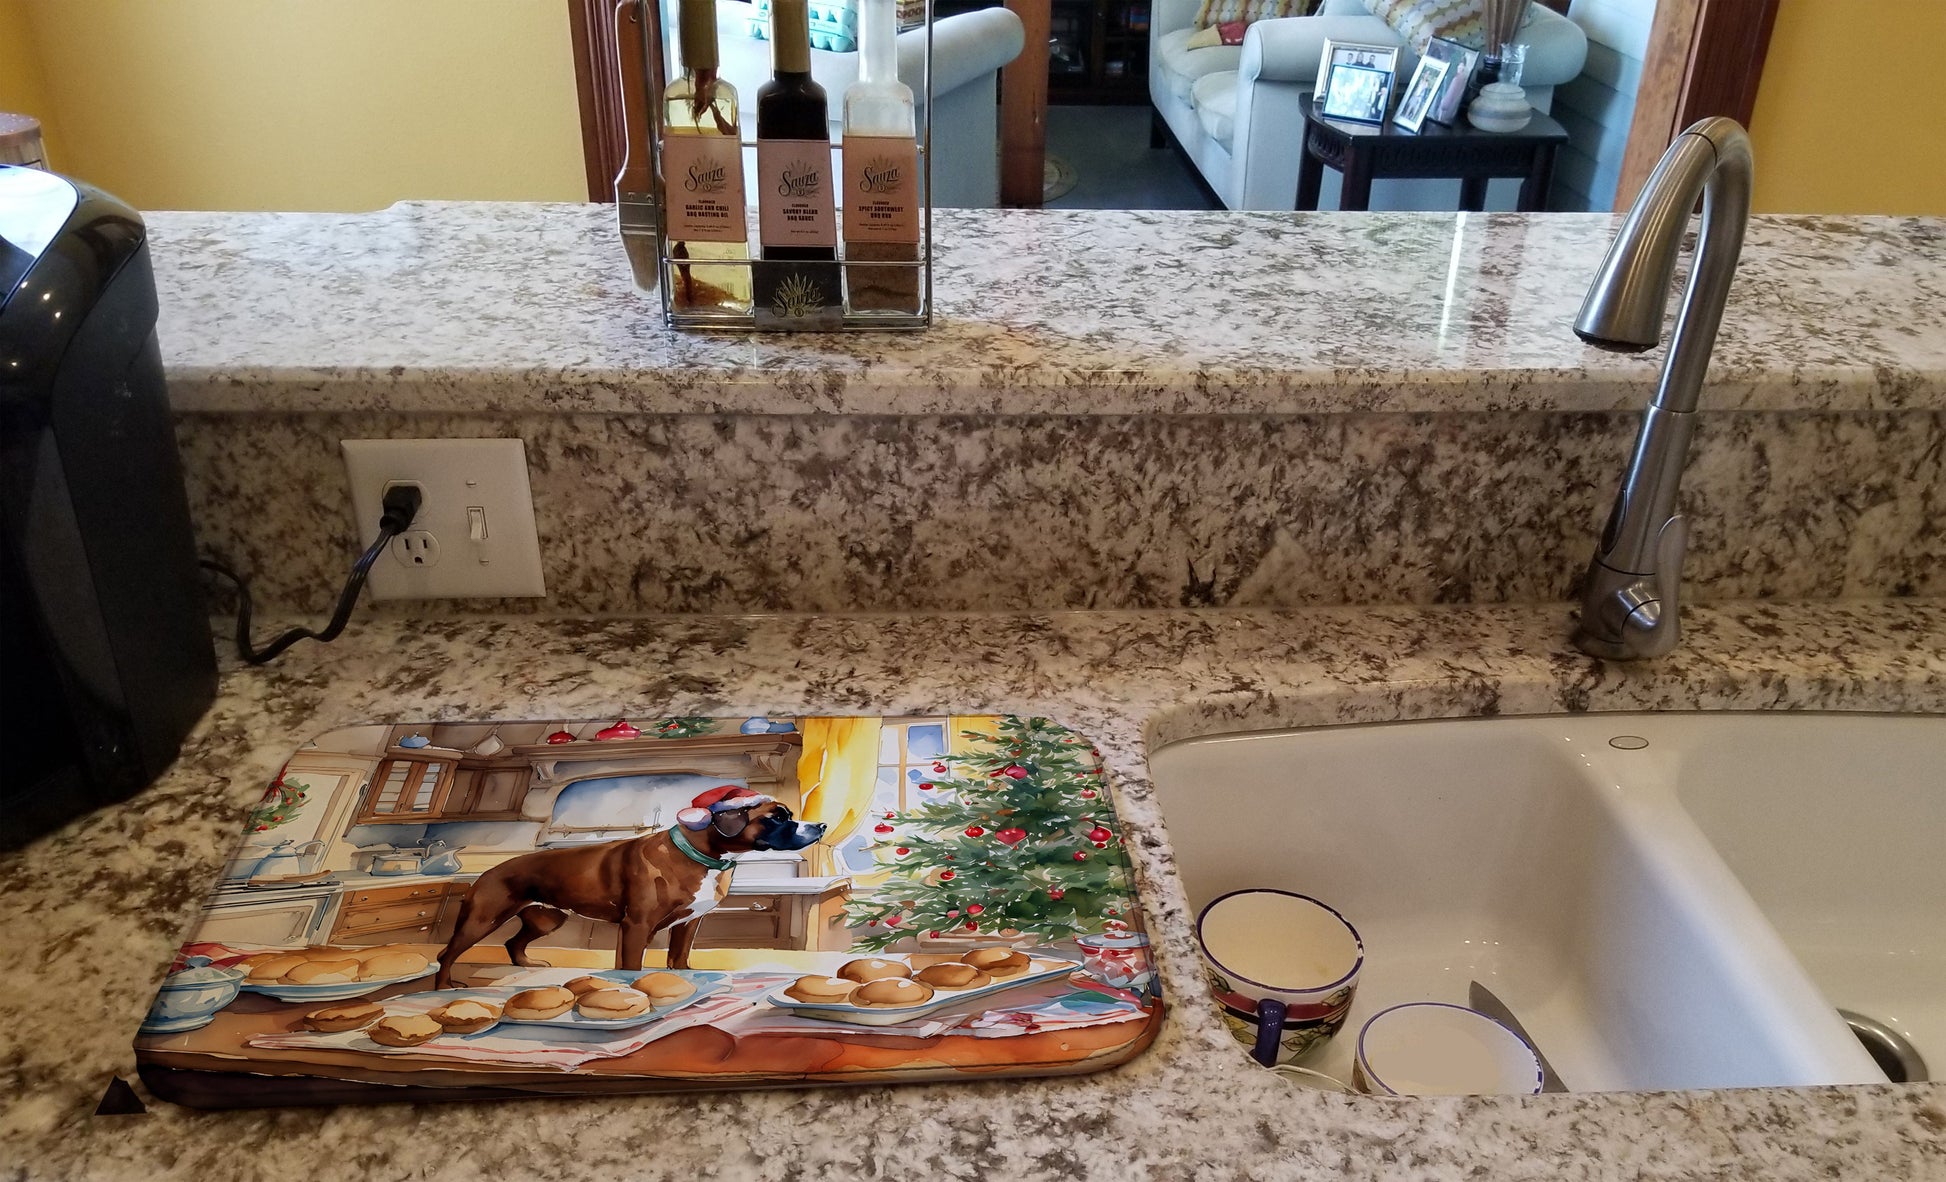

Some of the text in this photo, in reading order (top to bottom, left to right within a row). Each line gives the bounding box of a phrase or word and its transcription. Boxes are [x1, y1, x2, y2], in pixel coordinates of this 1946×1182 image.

[684, 165, 725, 192] Sauza
[778, 170, 819, 197] Sauza
[859, 166, 900, 193] Sauza
